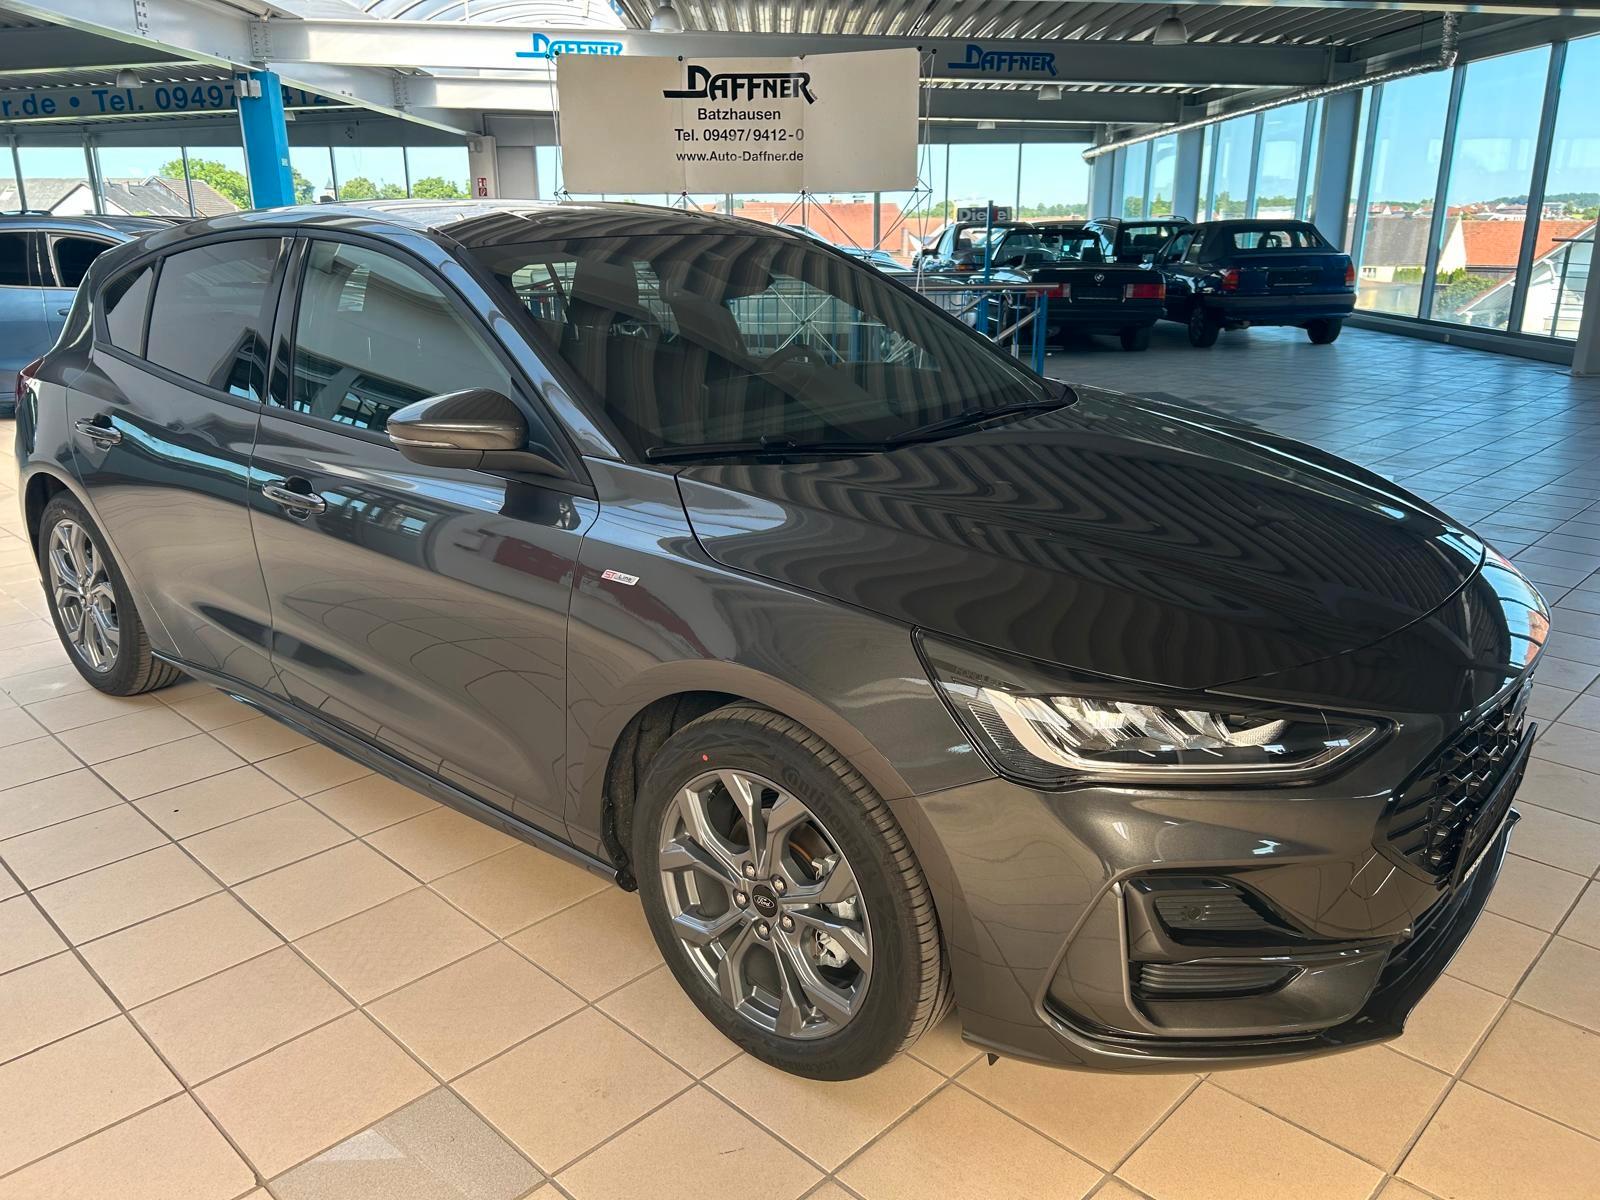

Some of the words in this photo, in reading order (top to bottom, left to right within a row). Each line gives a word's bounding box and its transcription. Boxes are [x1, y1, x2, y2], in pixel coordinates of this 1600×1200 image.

[948, 44, 1057, 76] DAFFNER
[663, 65, 816, 104] DAFFNER
[92, 88, 144, 112] Tel.
[697, 108, 781, 121] Batzhausen
[675, 129, 699, 141] Tel.
[676, 151, 804, 162] www.Auto-Daffner.de
[958, 207, 1011, 222] Dieel
